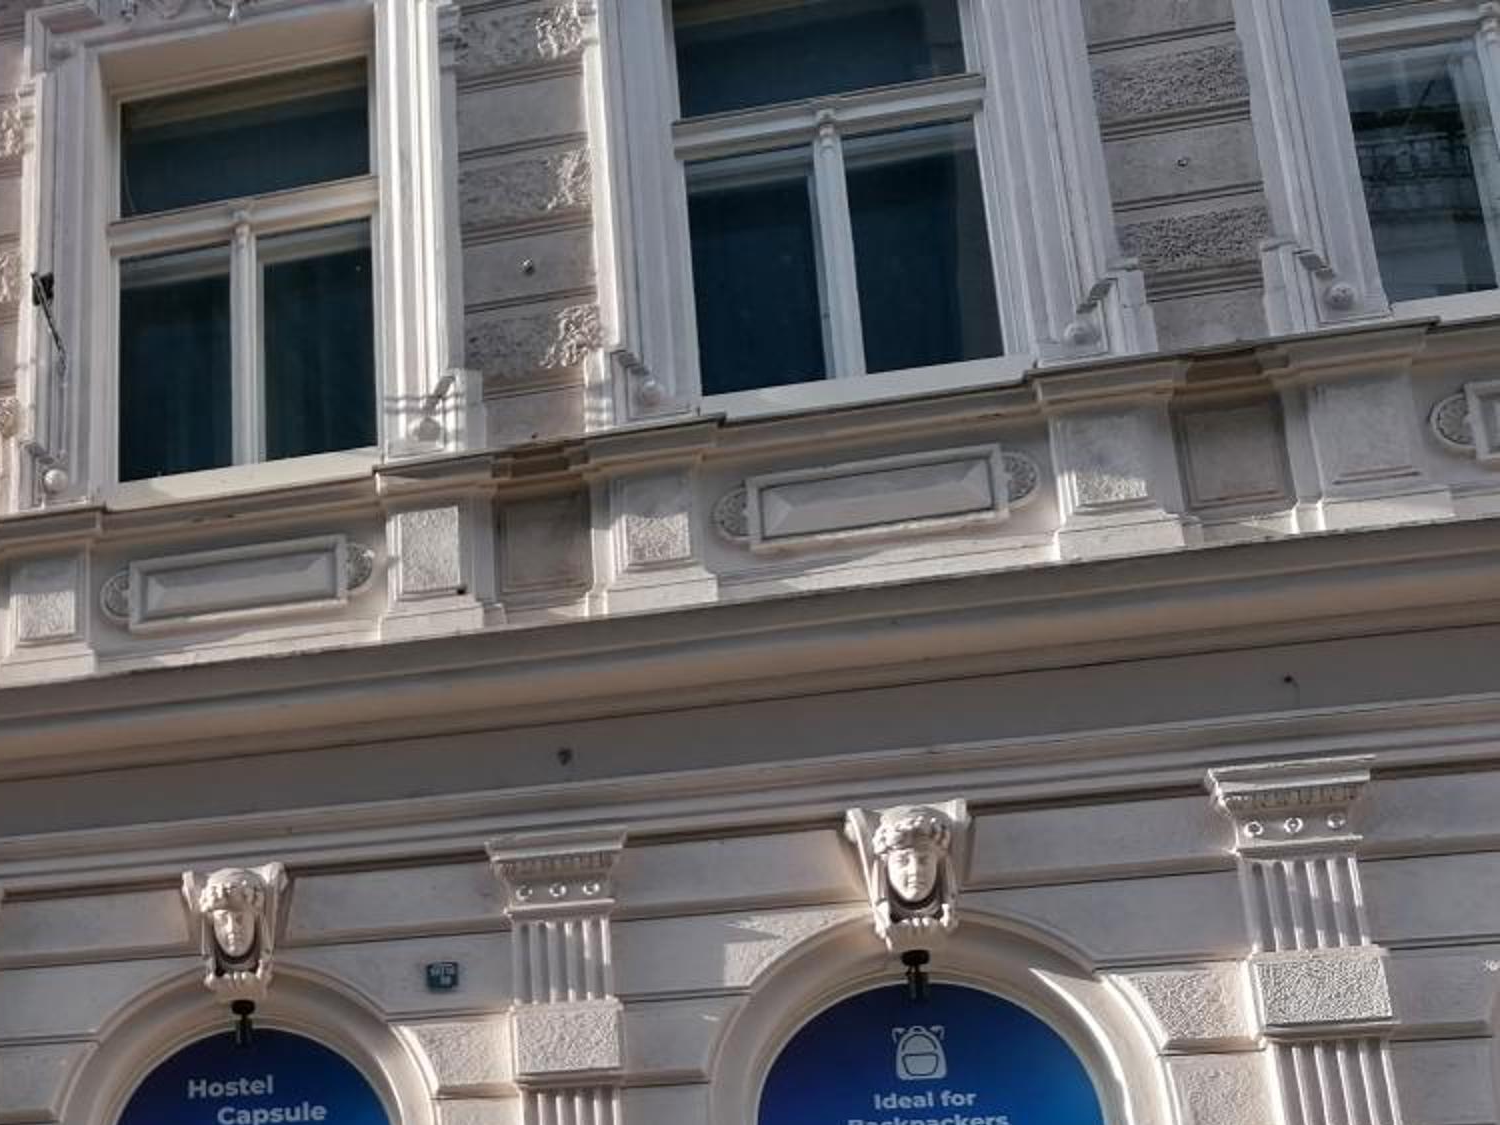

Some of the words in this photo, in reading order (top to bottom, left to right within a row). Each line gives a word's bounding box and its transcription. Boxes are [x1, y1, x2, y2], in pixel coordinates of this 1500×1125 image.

[187, 1074, 274, 1099] Hostel
[873, 1092, 935, 1110] Ideal
[940, 1090, 977, 1107] for
